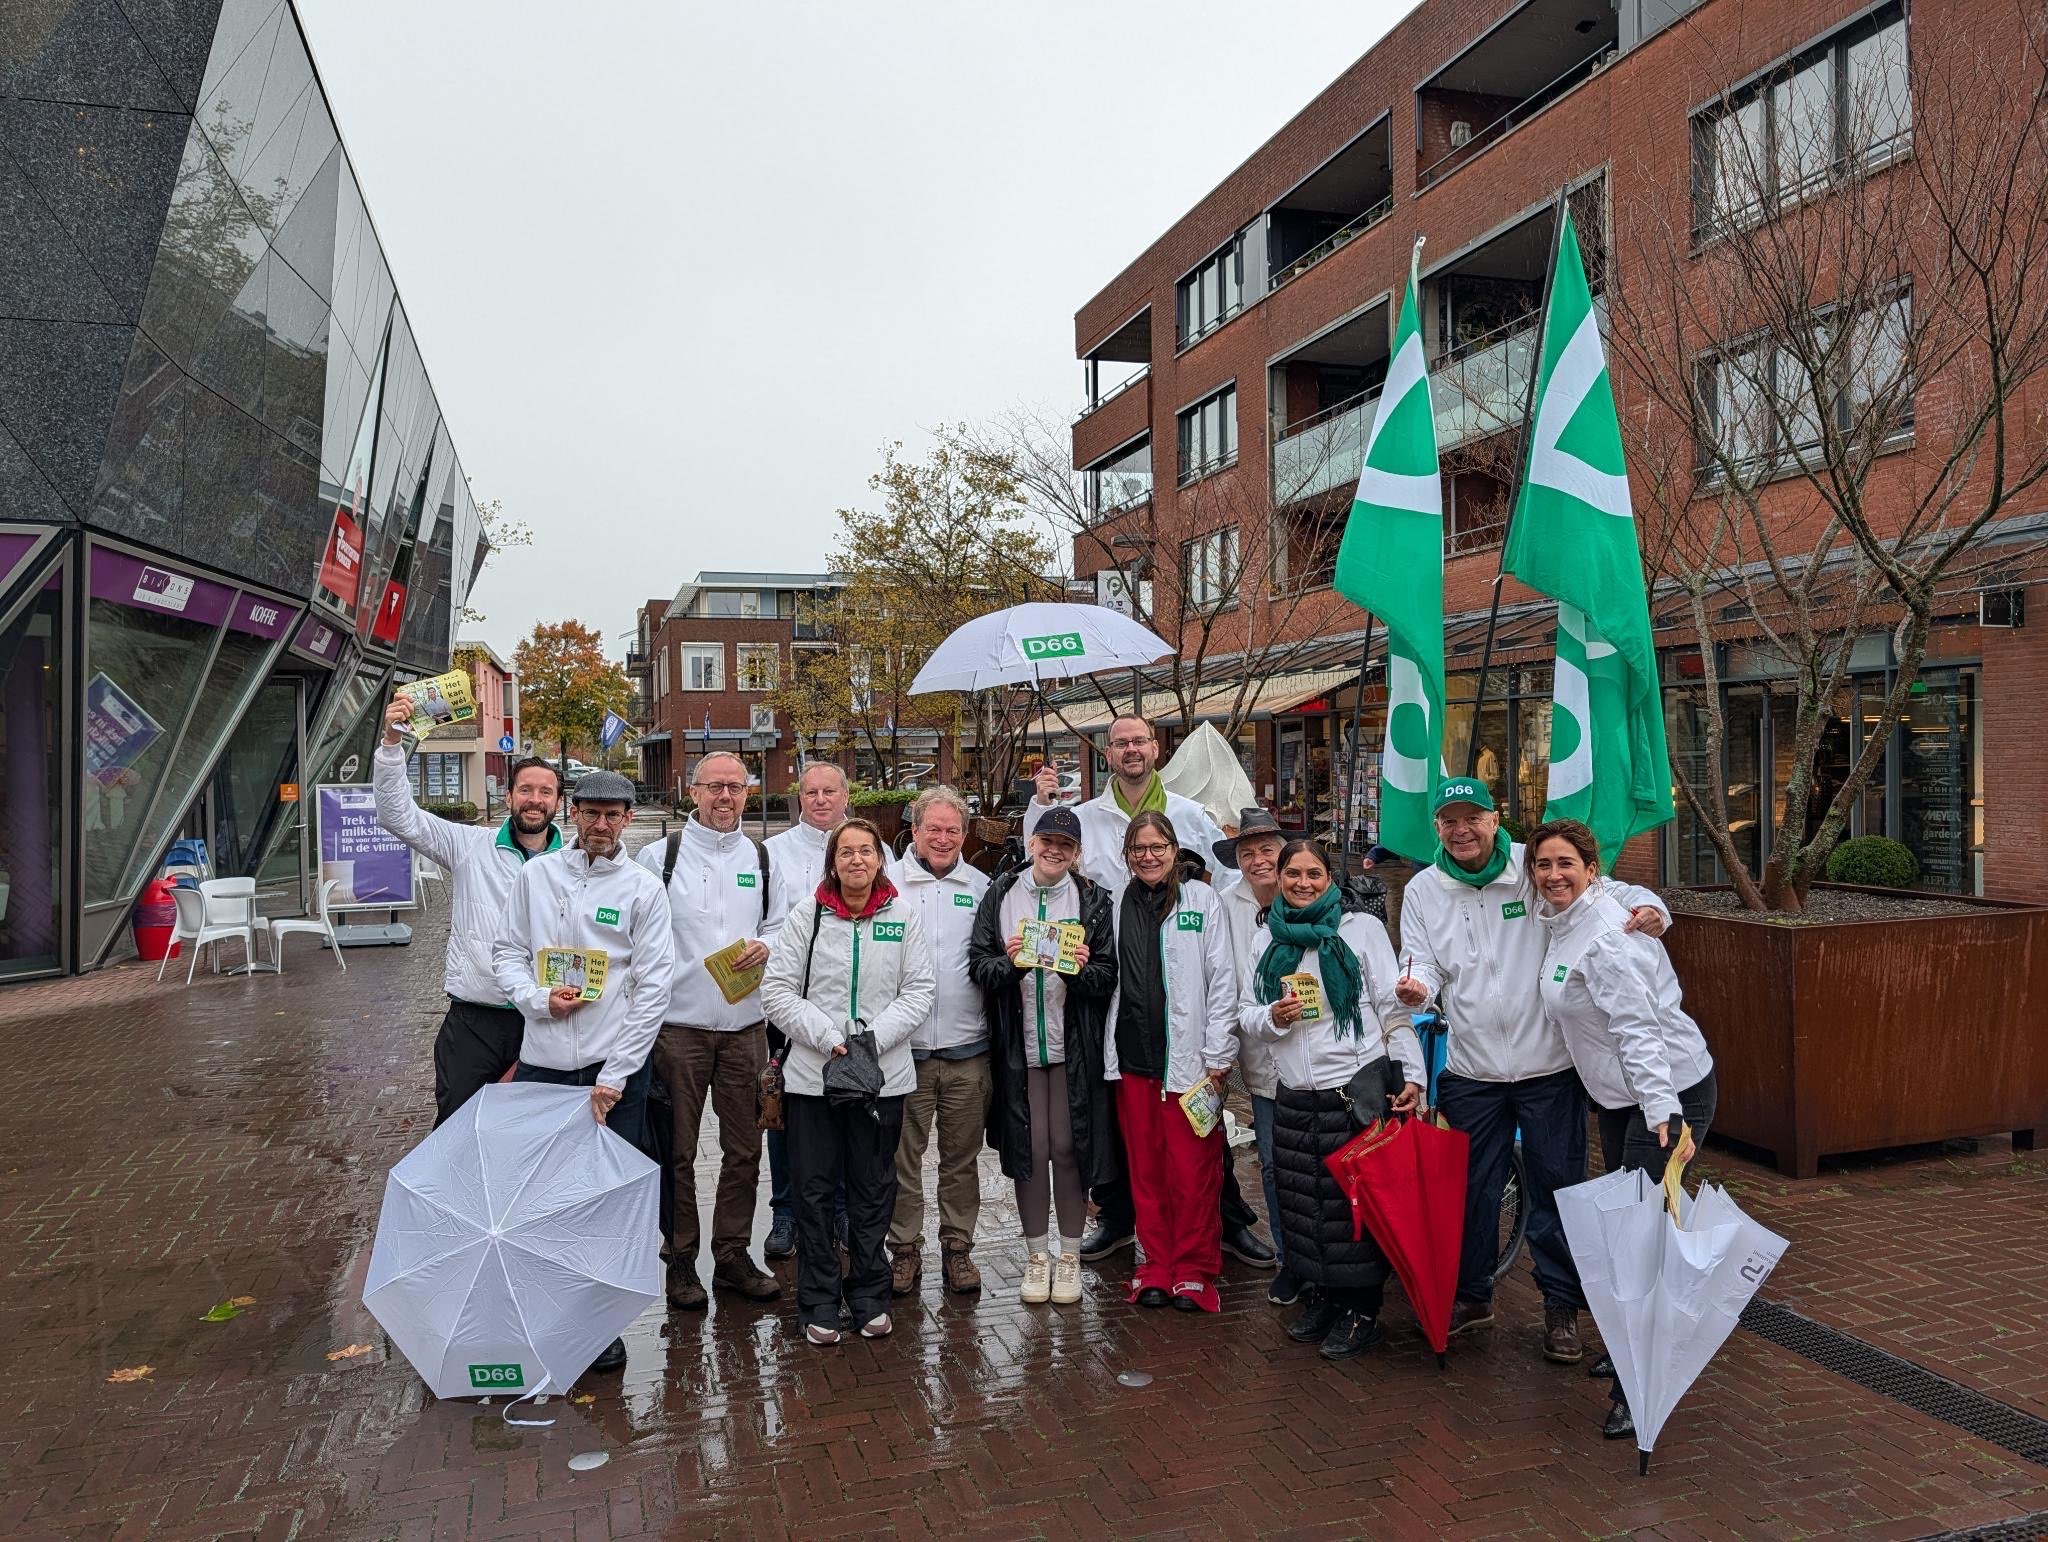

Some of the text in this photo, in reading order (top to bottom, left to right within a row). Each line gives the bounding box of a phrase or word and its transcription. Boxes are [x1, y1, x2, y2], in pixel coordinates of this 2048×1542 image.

[169, 583, 190, 596] ONS
[249, 604, 279, 626] KOFFIE
[1028, 636, 1077, 654] D66
[445, 680, 460, 689] Het
[447, 689, 464, 698] kan
[1445, 785, 1474, 797] D66
[1923, 810, 1960, 821] MEYER
[340, 815, 366, 826] Trek
[1923, 828, 1962, 840] gardeur
[341, 842, 407, 853] in de vitrine
[739, 876, 754, 884] D66
[1923, 875, 1962, 887] REPLAY
[955, 896, 972, 904] D66
[1504, 905, 1523, 915] D66
[598, 911, 617, 922] D66
[875, 925, 903, 936] D66
[1066, 931, 1080, 940] Het
[1063, 940, 1078, 948] kan
[1062, 949, 1075, 957] wé
[591, 958, 605, 967] Het
[1060, 961, 1073, 969] D66
[590, 967, 604, 976] kan
[1556, 969, 1565, 978] D66
[588, 977, 603, 985] wél
[1303, 1009, 1318, 1017] D66
[474, 1368, 518, 1382] D66
